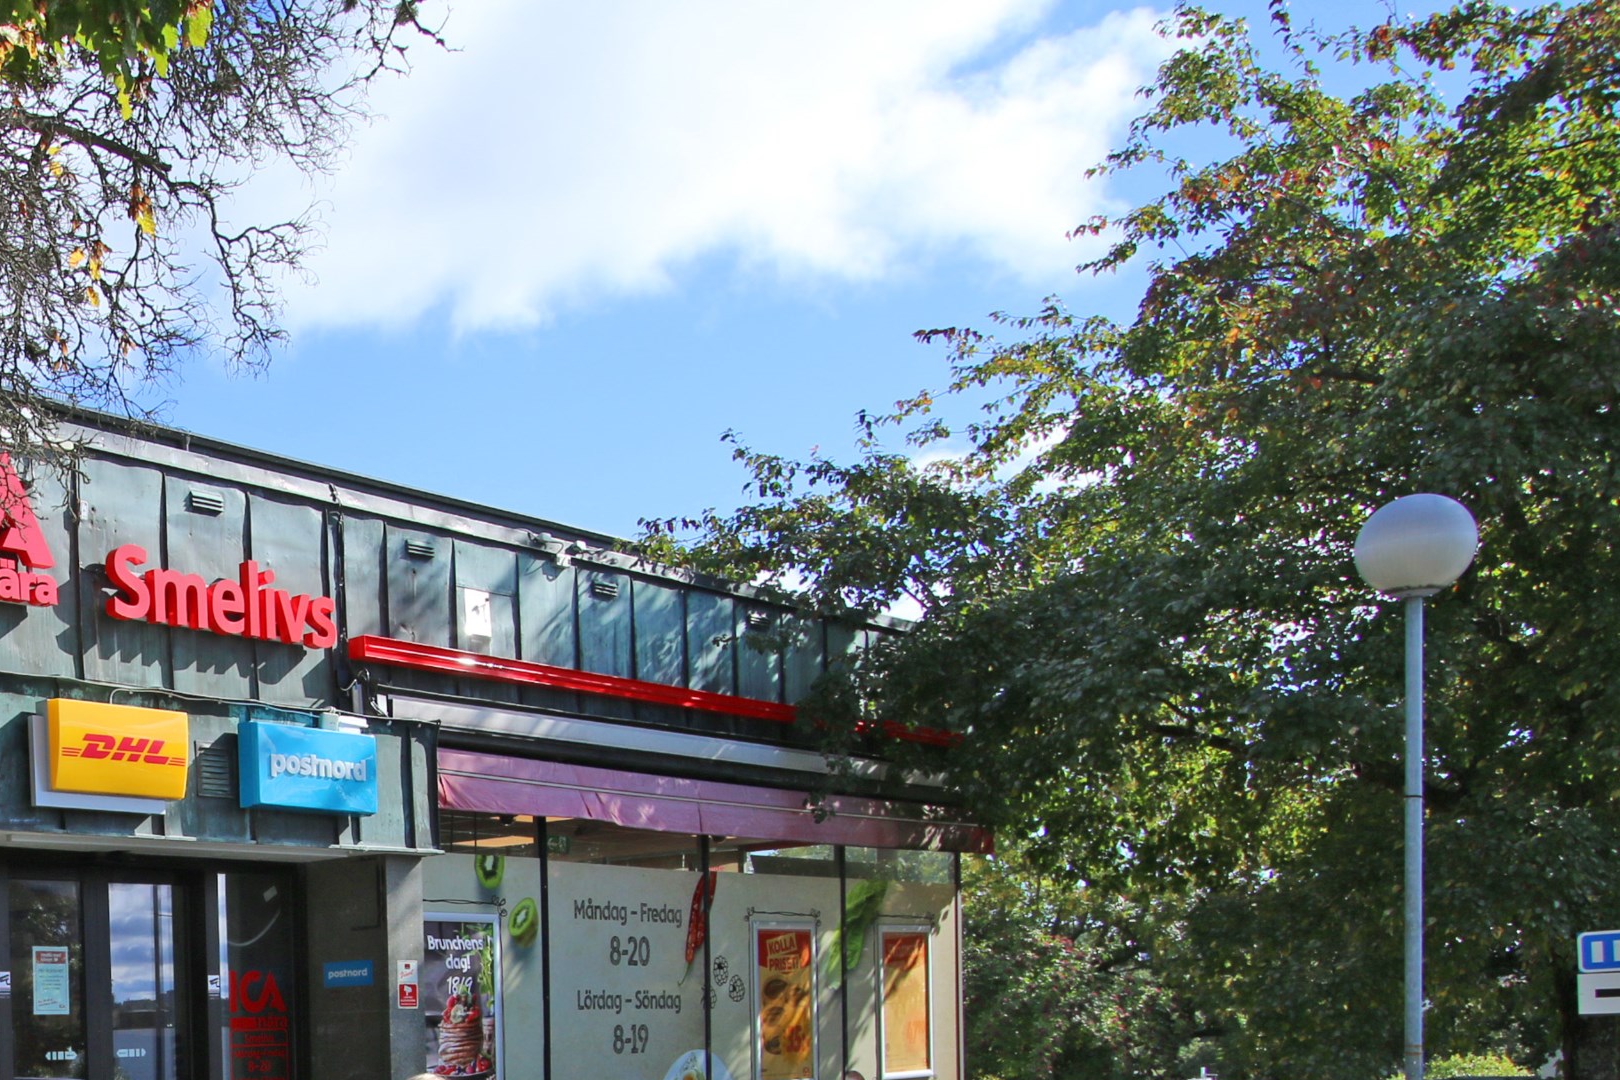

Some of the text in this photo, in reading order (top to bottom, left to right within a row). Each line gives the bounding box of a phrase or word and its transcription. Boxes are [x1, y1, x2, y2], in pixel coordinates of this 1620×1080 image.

[106, 544, 337, 648] Smelivs
[79, 733, 171, 765] DHL
[270, 753, 367, 782] postnord
[574, 898, 627, 925] Måndag
[640, 903, 682, 928] Fredag
[427, 935, 484, 950] Brunchens
[610, 936, 650, 966] 8-20
[769, 936, 795, 954] KOLLA
[328, 968, 368, 979] postnord
[446, 954, 471, 972] dag!
[769, 956, 799, 972] PRISET!
[229, 969, 287, 1013] ICA
[446, 976, 473, 994] 18/9
[577, 990, 622, 1014] Lördag
[635, 990, 682, 1014] Söndag
[613, 1024, 649, 1054] 8-19
